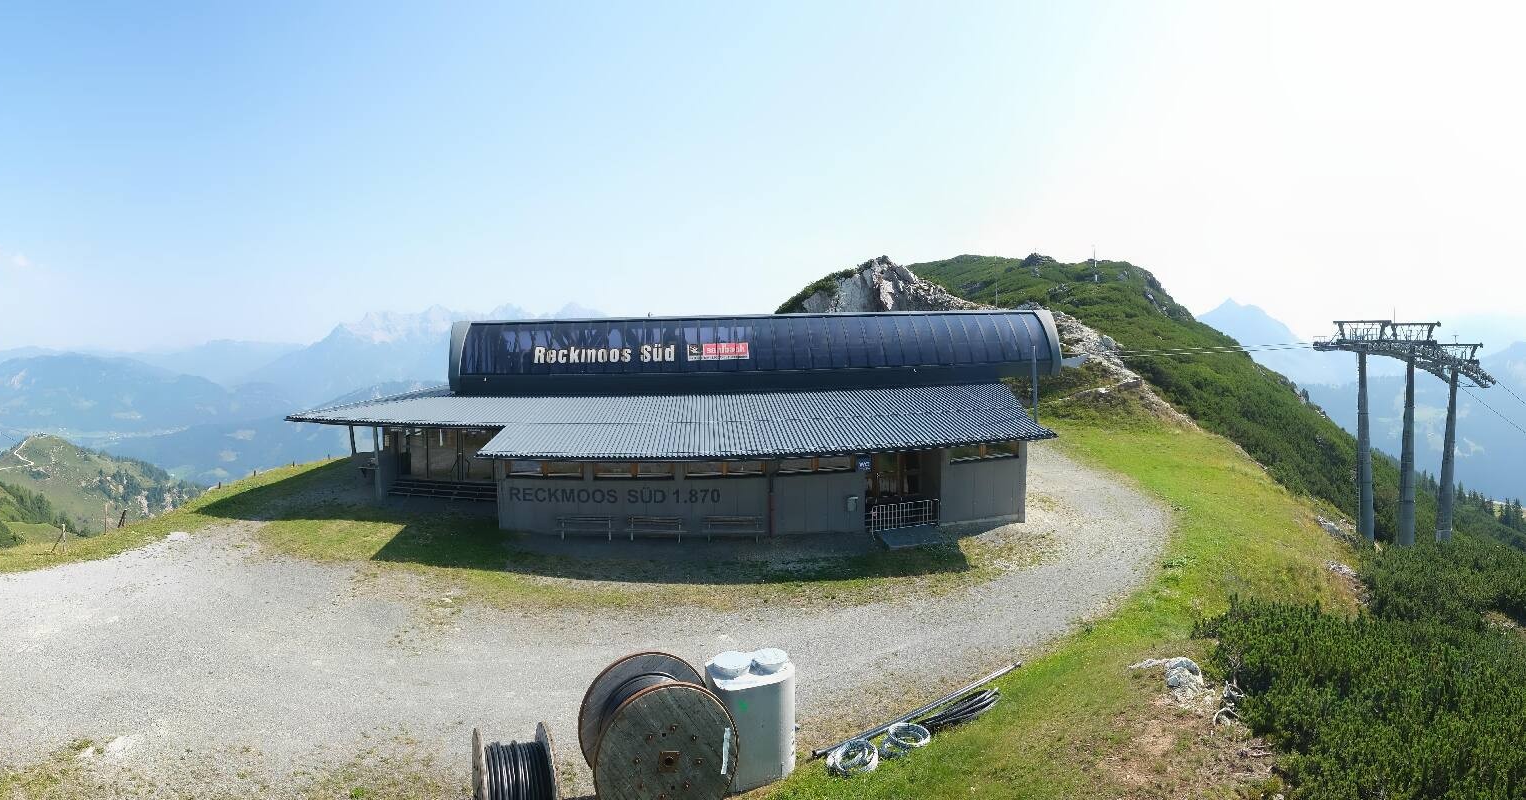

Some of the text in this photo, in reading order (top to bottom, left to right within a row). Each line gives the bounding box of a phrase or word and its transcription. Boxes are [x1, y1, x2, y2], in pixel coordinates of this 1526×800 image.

[533, 343, 675, 364] Reckmoos Süd
[508, 486, 721, 504] RECKMOOS SÜD 1.870
